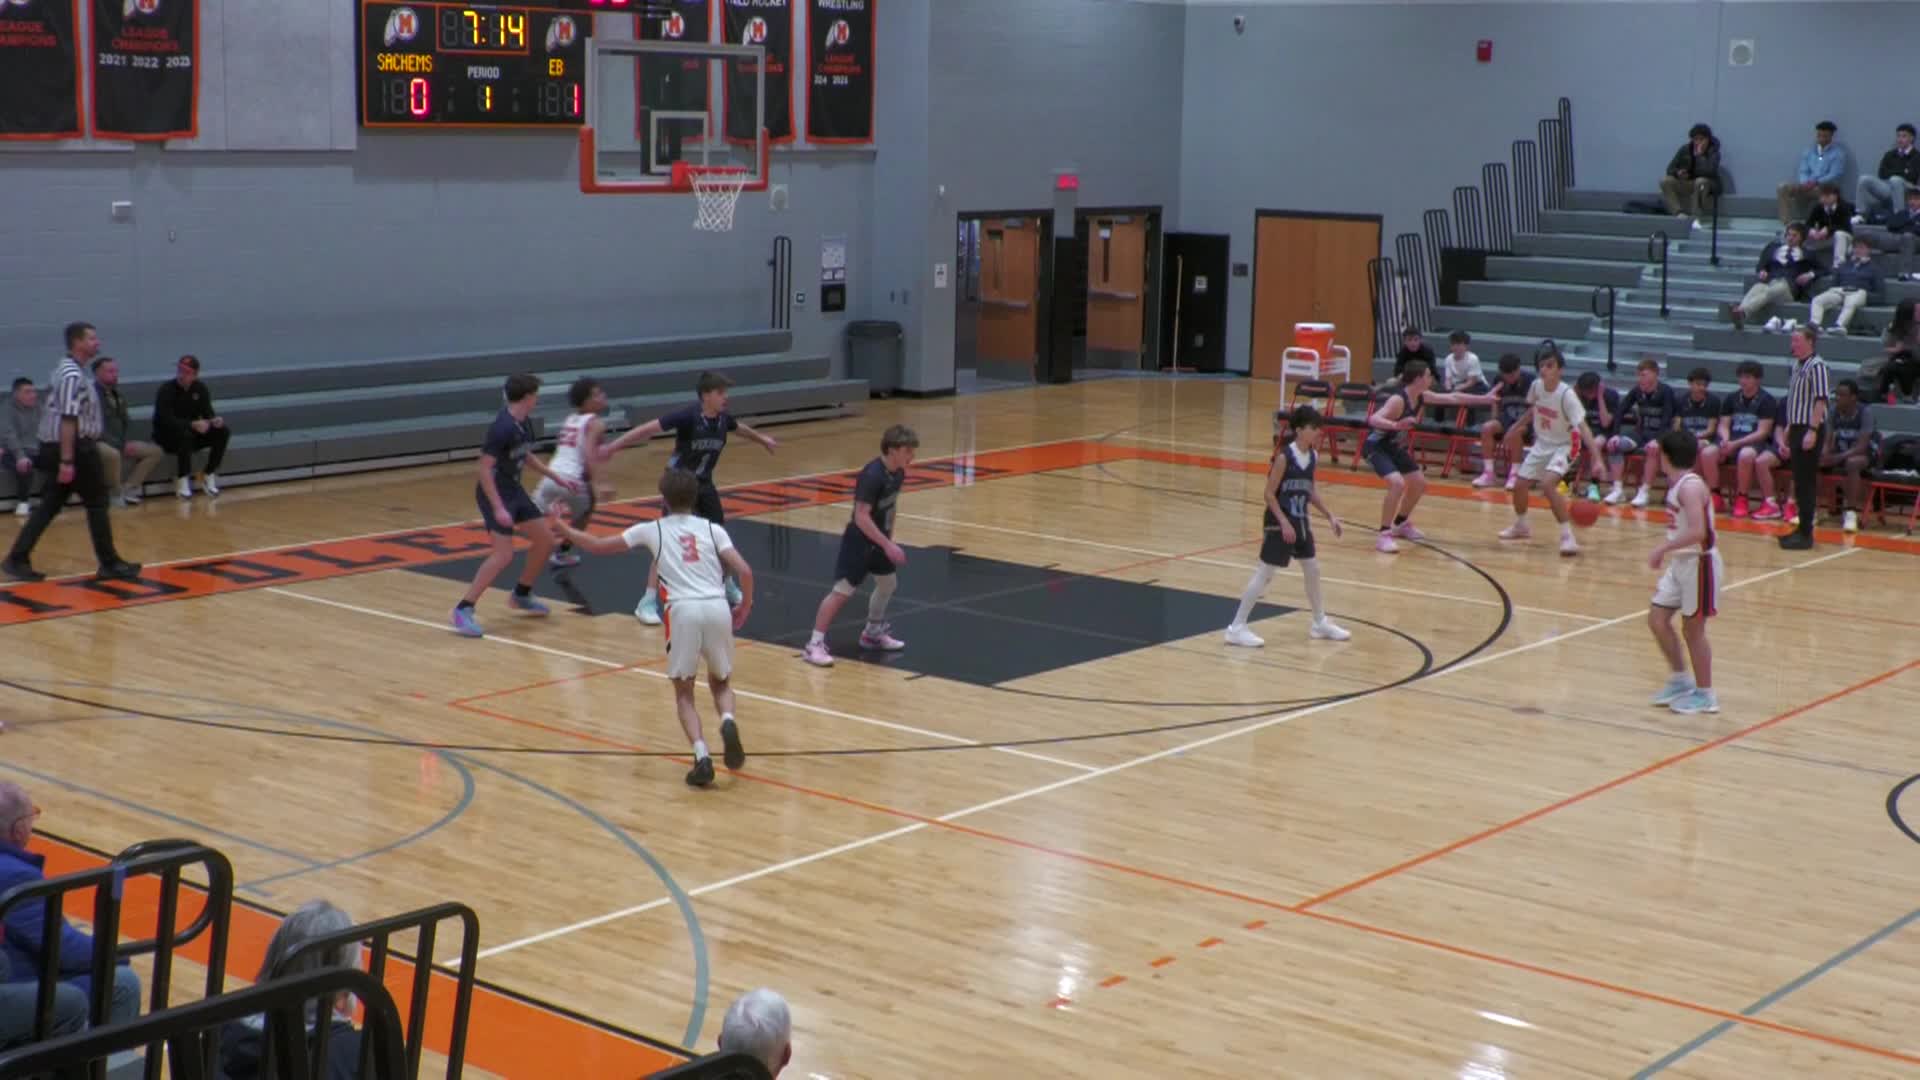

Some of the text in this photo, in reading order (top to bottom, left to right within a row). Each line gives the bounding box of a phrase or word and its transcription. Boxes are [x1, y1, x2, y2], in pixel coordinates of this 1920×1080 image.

[463, 10, 524, 46] 7:14
[99, 53, 127, 66] 2021
[132, 55, 159, 68] 2022
[377, 53, 433, 73] SACHEMS
[467, 66, 500, 79] PERIOD
[548, 58, 565, 76] EB
[410, 78, 429, 115] 0
[484, 85, 491, 110] 1
[572, 83, 580, 115] 1
[679, 533, 700, 563] 3
